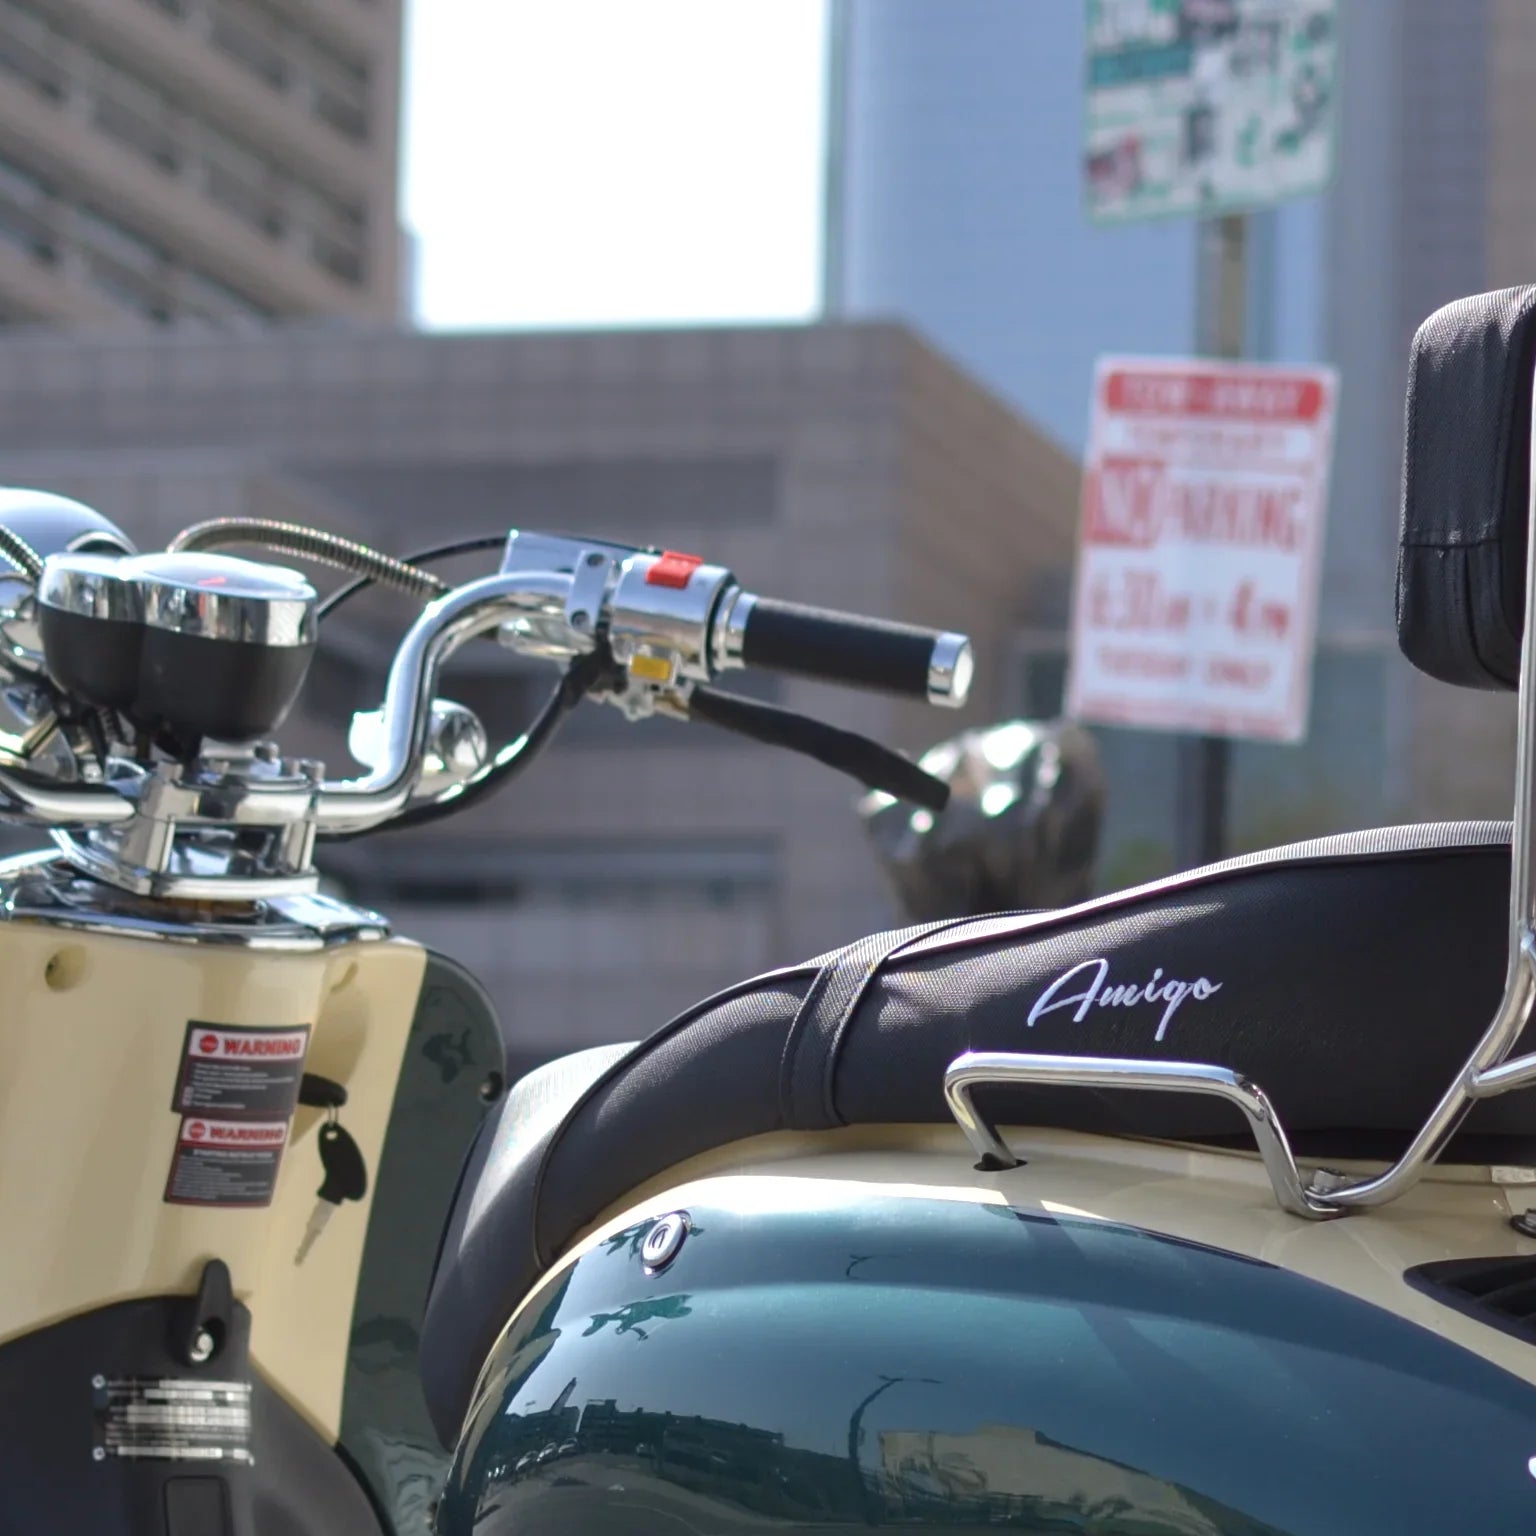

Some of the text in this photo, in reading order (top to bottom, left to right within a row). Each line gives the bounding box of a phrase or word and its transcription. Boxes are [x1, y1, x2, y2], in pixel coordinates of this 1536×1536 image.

[1027, 958, 1223, 1041] Amigo
[223, 1037, 301, 1056] WARNING
[209, 1126, 284, 1140] WARNING
